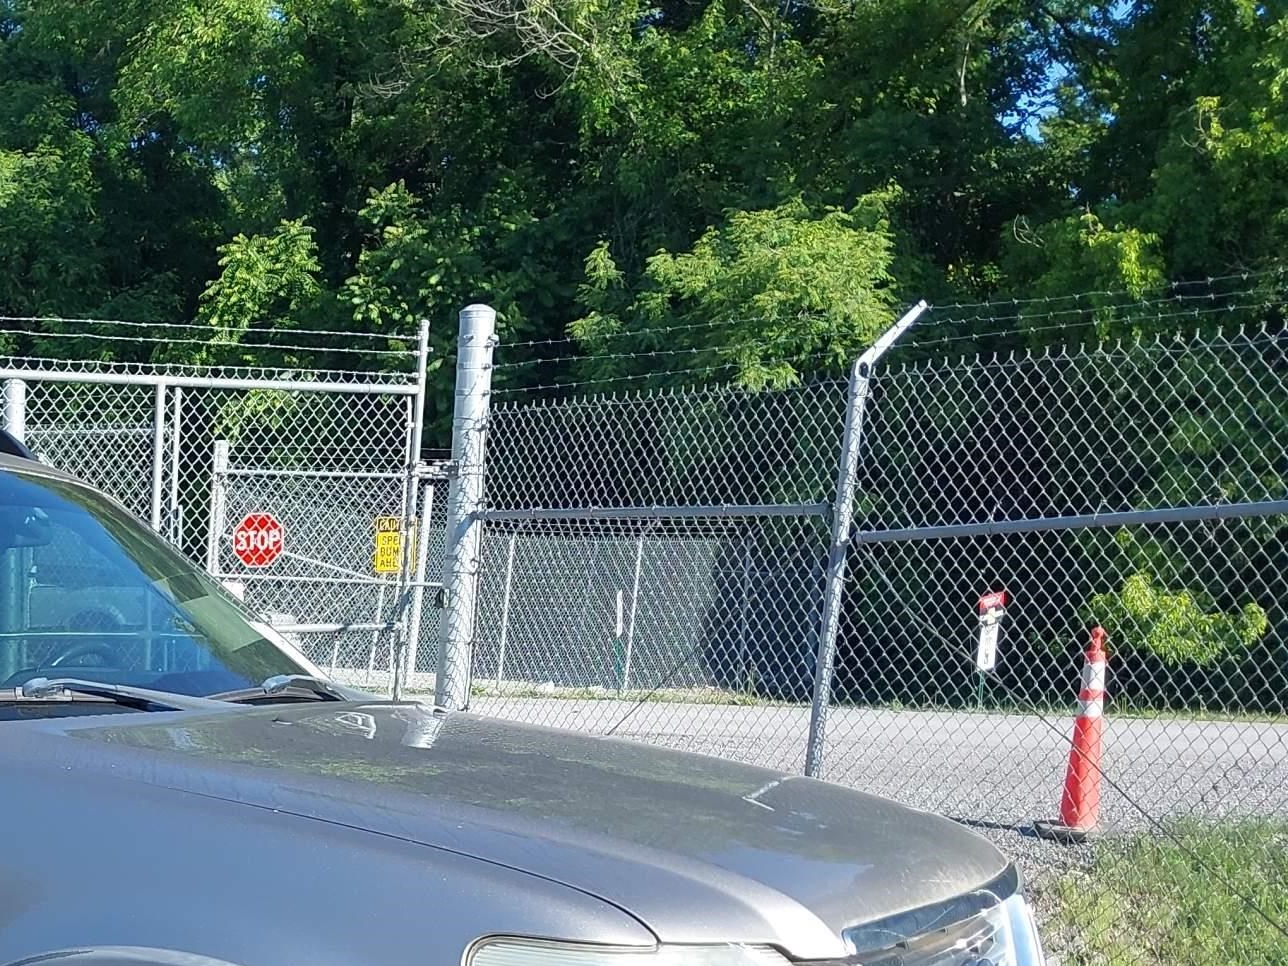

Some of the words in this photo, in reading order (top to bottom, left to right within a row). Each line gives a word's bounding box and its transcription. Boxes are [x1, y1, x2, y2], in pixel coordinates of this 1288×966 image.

[236, 530, 281, 551] STOP
[382, 535, 399, 546] SPE
[380, 546, 399, 557] BUM
